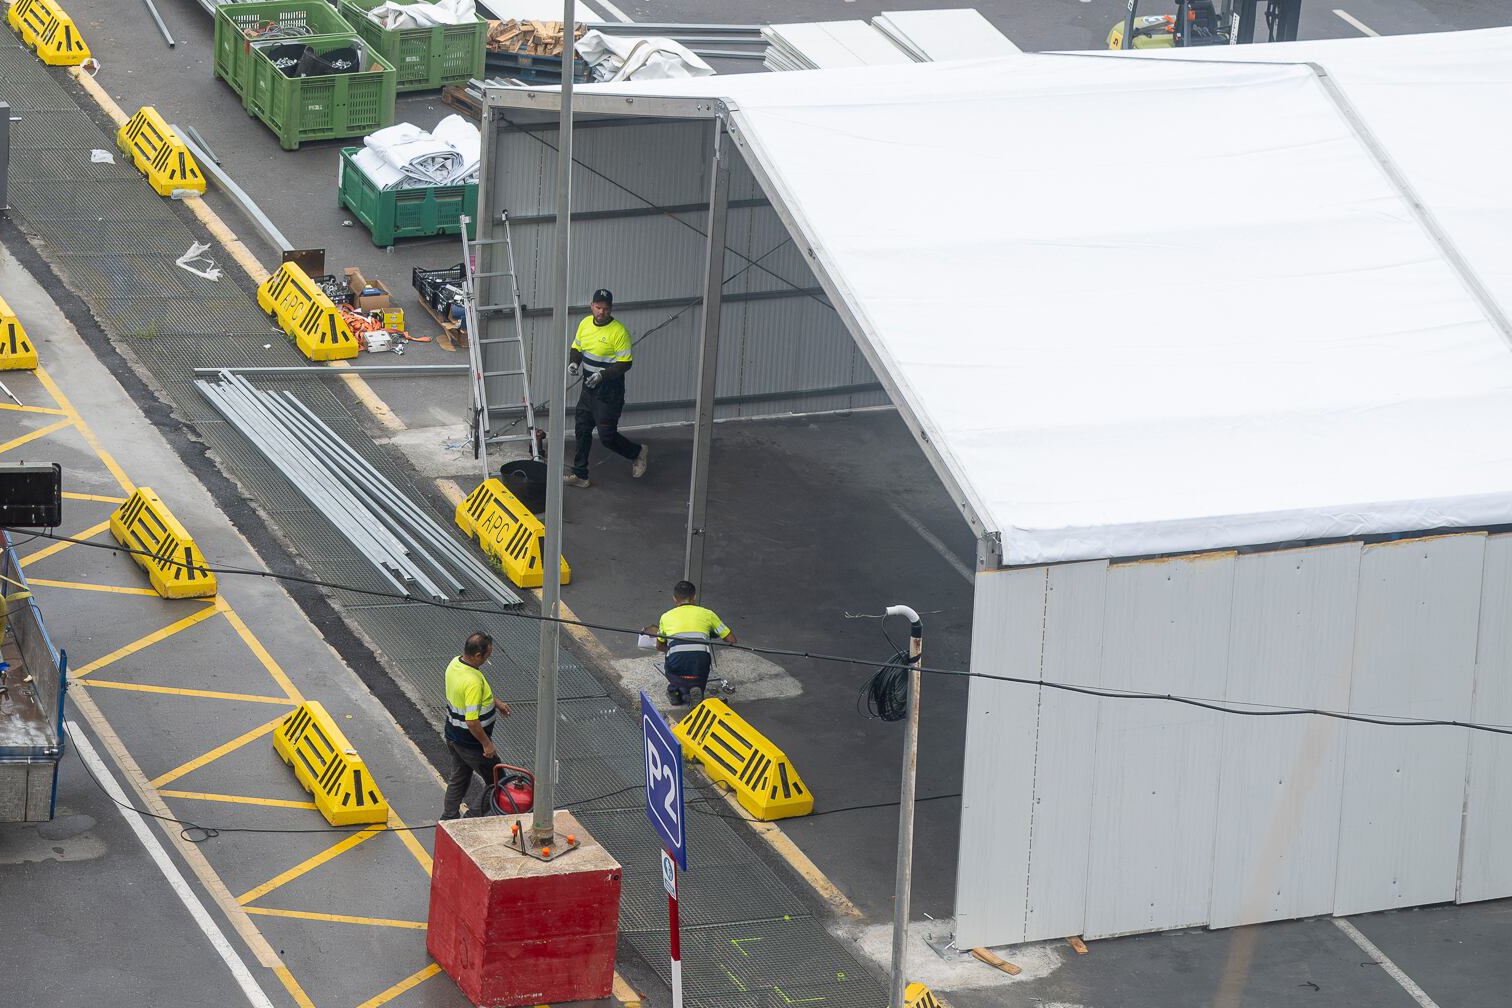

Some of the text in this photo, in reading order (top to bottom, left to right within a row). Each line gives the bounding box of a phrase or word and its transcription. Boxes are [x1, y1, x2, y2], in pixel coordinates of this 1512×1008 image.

[280, 291, 304, 320] APC
[482, 510, 510, 544] APC
[647, 737, 678, 824] P2
